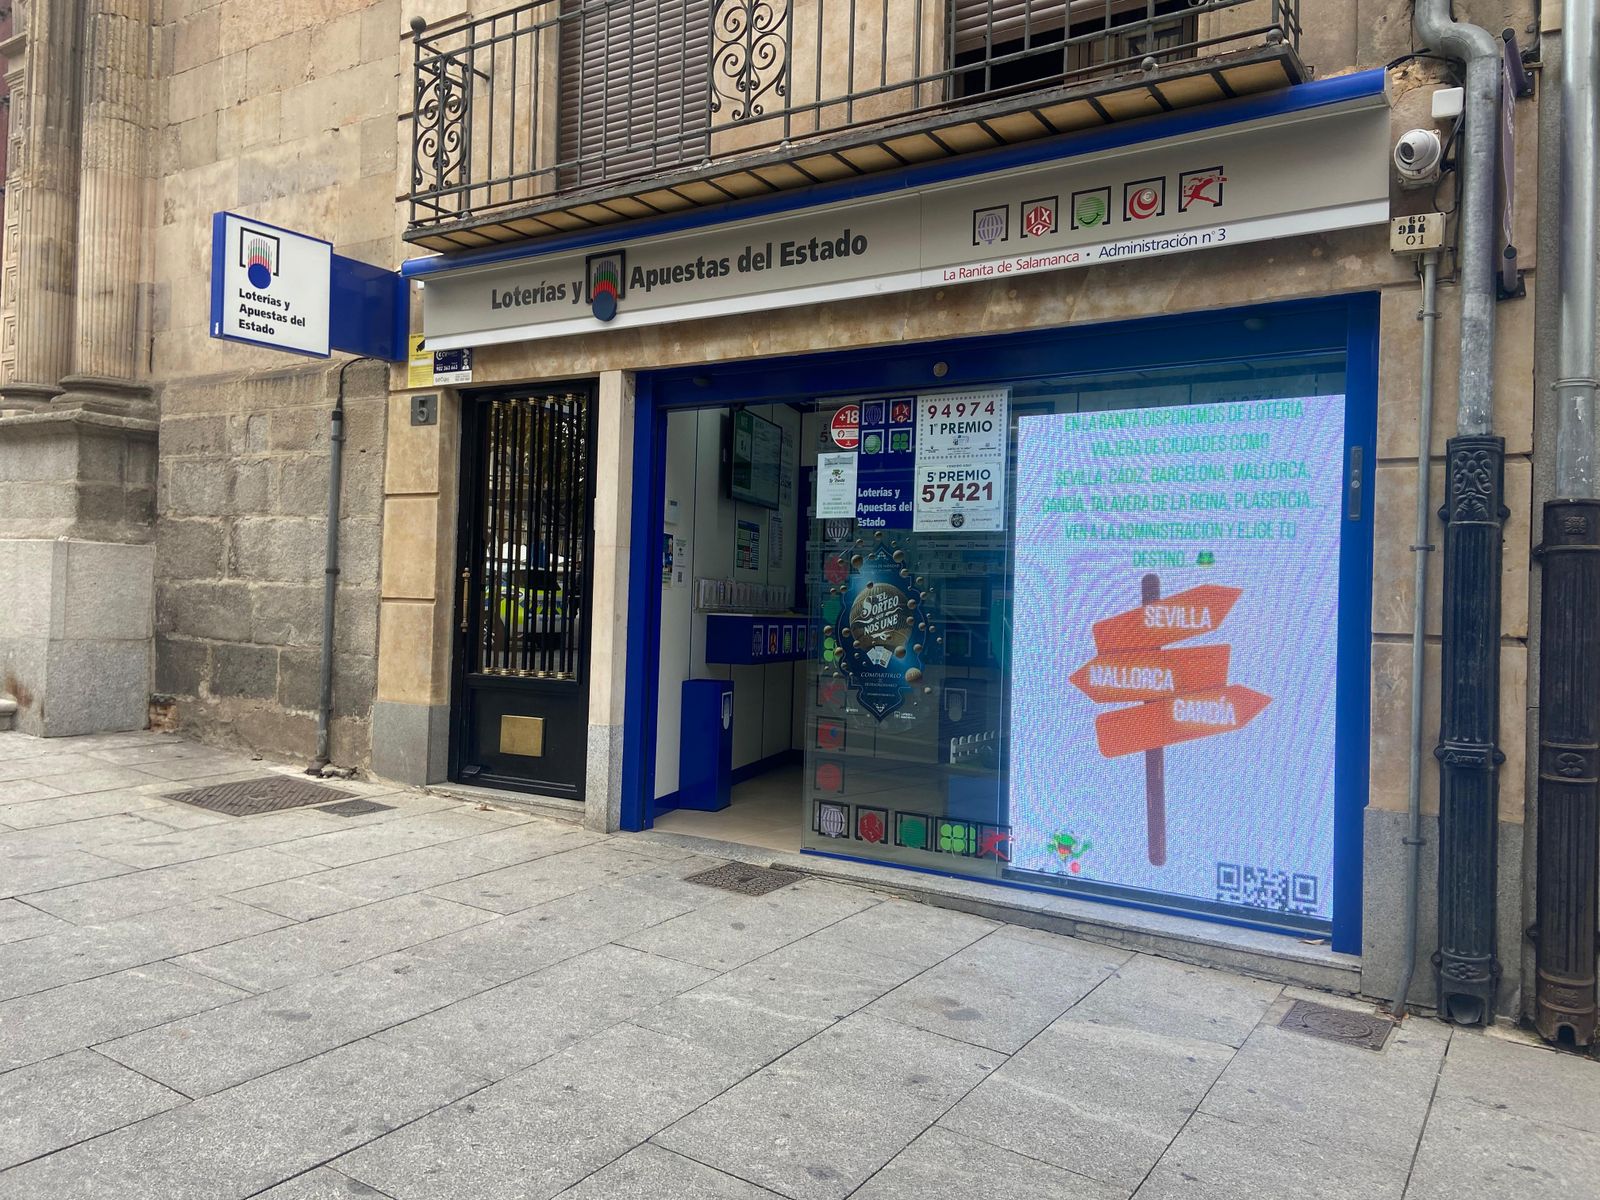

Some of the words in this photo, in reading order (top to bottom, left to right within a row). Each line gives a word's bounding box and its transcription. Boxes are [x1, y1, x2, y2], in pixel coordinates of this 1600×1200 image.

[943, 270, 956, 281] La
[959, 264, 993, 279] Ranita
[997, 260, 1012, 273] de
[1016, 252, 1080, 270] Salamanca
[1099, 232, 1198, 259] Administración
[1217, 228, 1227, 241] 3
[491, 280, 566, 310] Loterías
[572, 279, 583, 305] y
[629, 255, 731, 292] Apuestas
[738, 242, 772, 273] del
[780, 229, 868, 267] Estado
[239, 288, 281, 307] Loterías
[284, 301, 290, 311] y
[239, 304, 287, 323] Apuestas
[290, 315, 306, 327] del
[239, 319, 275, 335] Estado
[417, 399, 429, 423] 5
[839, 410, 859, 424] +18
[927, 401, 995, 420] 94974
[1065, 416, 1079, 432] EN
[1082, 415, 1097, 431] LA
[1099, 411, 1139, 430] RANITA
[1143, 405, 1225, 427] DISPONEMOS
[1228, 404, 1246, 422] DE
[940, 420, 993, 434] PREMIO
[1092, 439, 1141, 457] VIAJERA
[1144, 438, 1160, 455] DE
[1163, 434, 1227, 454] CIUDADES
[1230, 432, 1271, 451] COMO
[939, 469, 991, 482] PREMIO
[858, 487, 893, 498] Loterías
[895, 489, 901, 499] y
[922, 482, 993, 503] 57421
[1091, 494, 1149, 512] TALAVERA
[1152, 494, 1168, 511] DE
[1170, 493, 1186, 511] LA
[857, 502, 896, 514] Apuestas
[898, 501, 913, 512] del
[857, 517, 886, 527] Estado
[1065, 522, 1087, 540] VEN
[1090, 523, 1098, 538] A
[1100, 522, 1116, 540] LA
[1226, 522, 1234, 539] Y
[1238, 521, 1274, 539] ELIGE
[1279, 521, 1297, 539] TU
[864, 621, 880, 636] NOS
[880, 614, 899, 630] UNE
[1144, 605, 1212, 629] SEVILLA
[1088, 664, 1175, 692] MALLORCA
